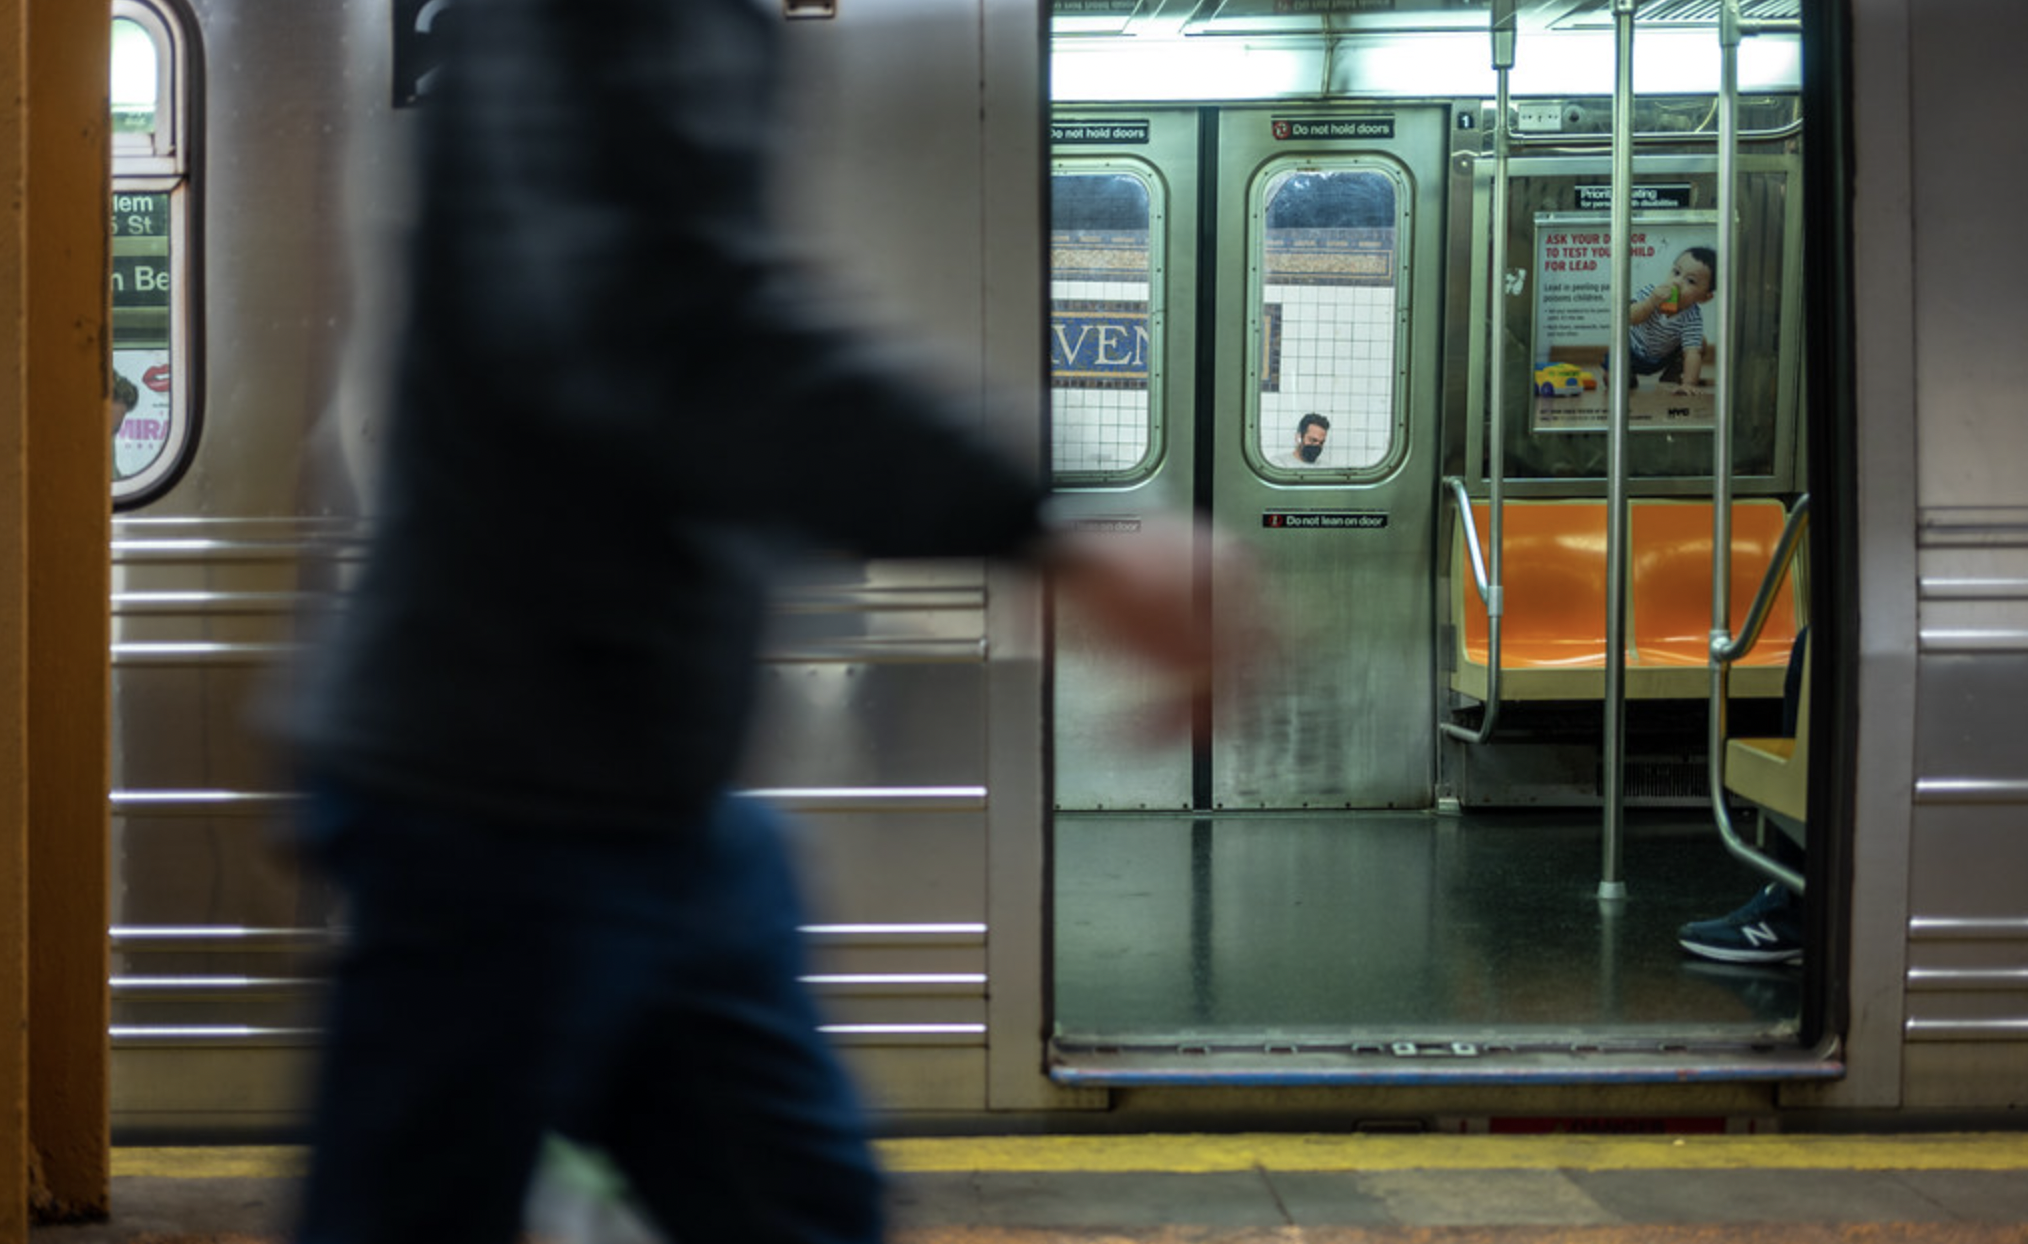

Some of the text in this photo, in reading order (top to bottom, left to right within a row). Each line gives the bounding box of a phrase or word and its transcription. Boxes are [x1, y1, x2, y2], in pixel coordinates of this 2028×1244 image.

[1461, 115, 1470, 128] 1
[1065, 127, 1083, 138] not
[1086, 127, 1111, 138] hold
[1112, 127, 1145, 138] doors
[1292, 123, 1390, 135] Do not hold doors
[127, 215, 153, 235] St
[1545, 233, 1568, 245] ASK
[1570, 233, 1601, 245] YOUR
[1545, 246, 1655, 258] TO TEST YOU HILD
[1544, 260, 1598, 272] FOR LEAD
[1114, 521, 1139, 531] door
[1286, 515, 1384, 526] Do not lean on door
[1742, 922, 1777, 946] N
